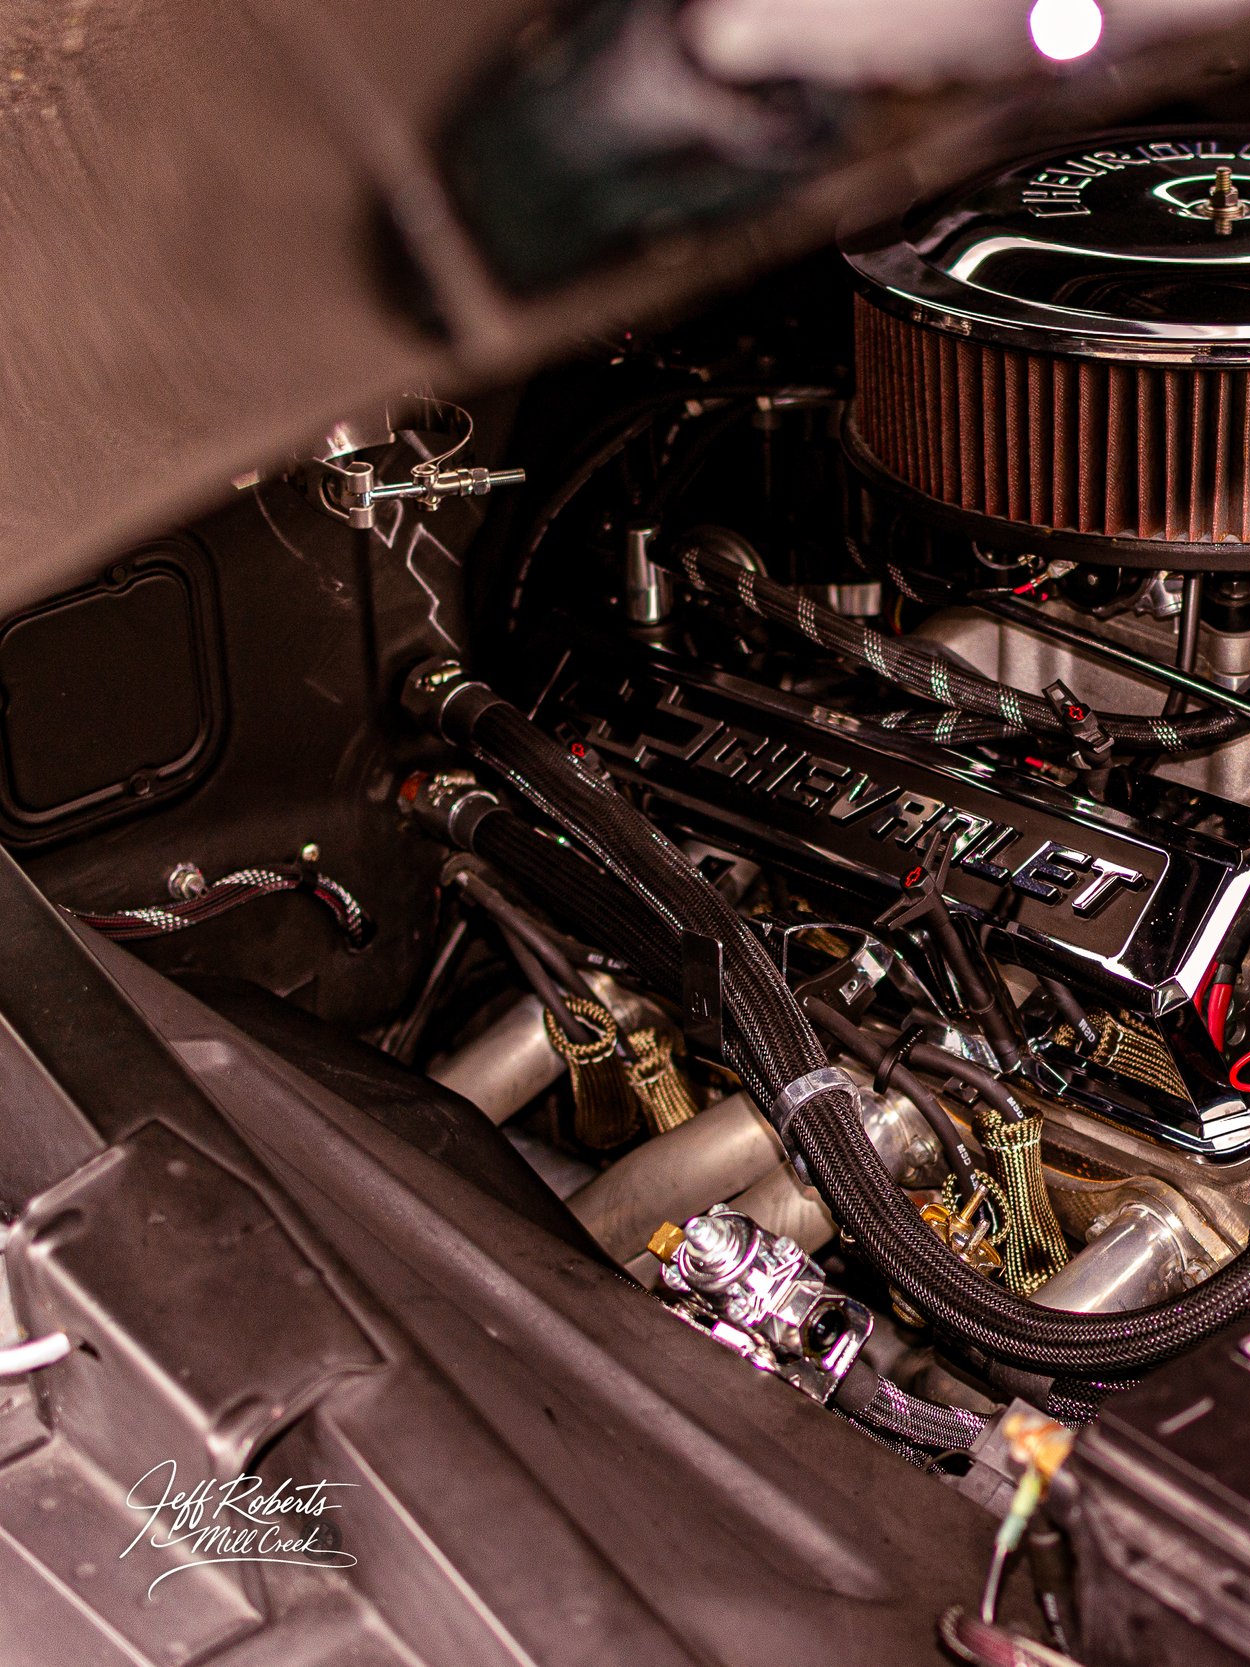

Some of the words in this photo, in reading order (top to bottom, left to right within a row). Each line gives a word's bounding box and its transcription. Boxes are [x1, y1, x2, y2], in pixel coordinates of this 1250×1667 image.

[710, 725, 1148, 919] CHEVROLET
[1077, 1017, 1096, 1043] MSD
[1006, 1096, 1025, 1119] MSD
[956, 1143, 972, 1167] MSD
